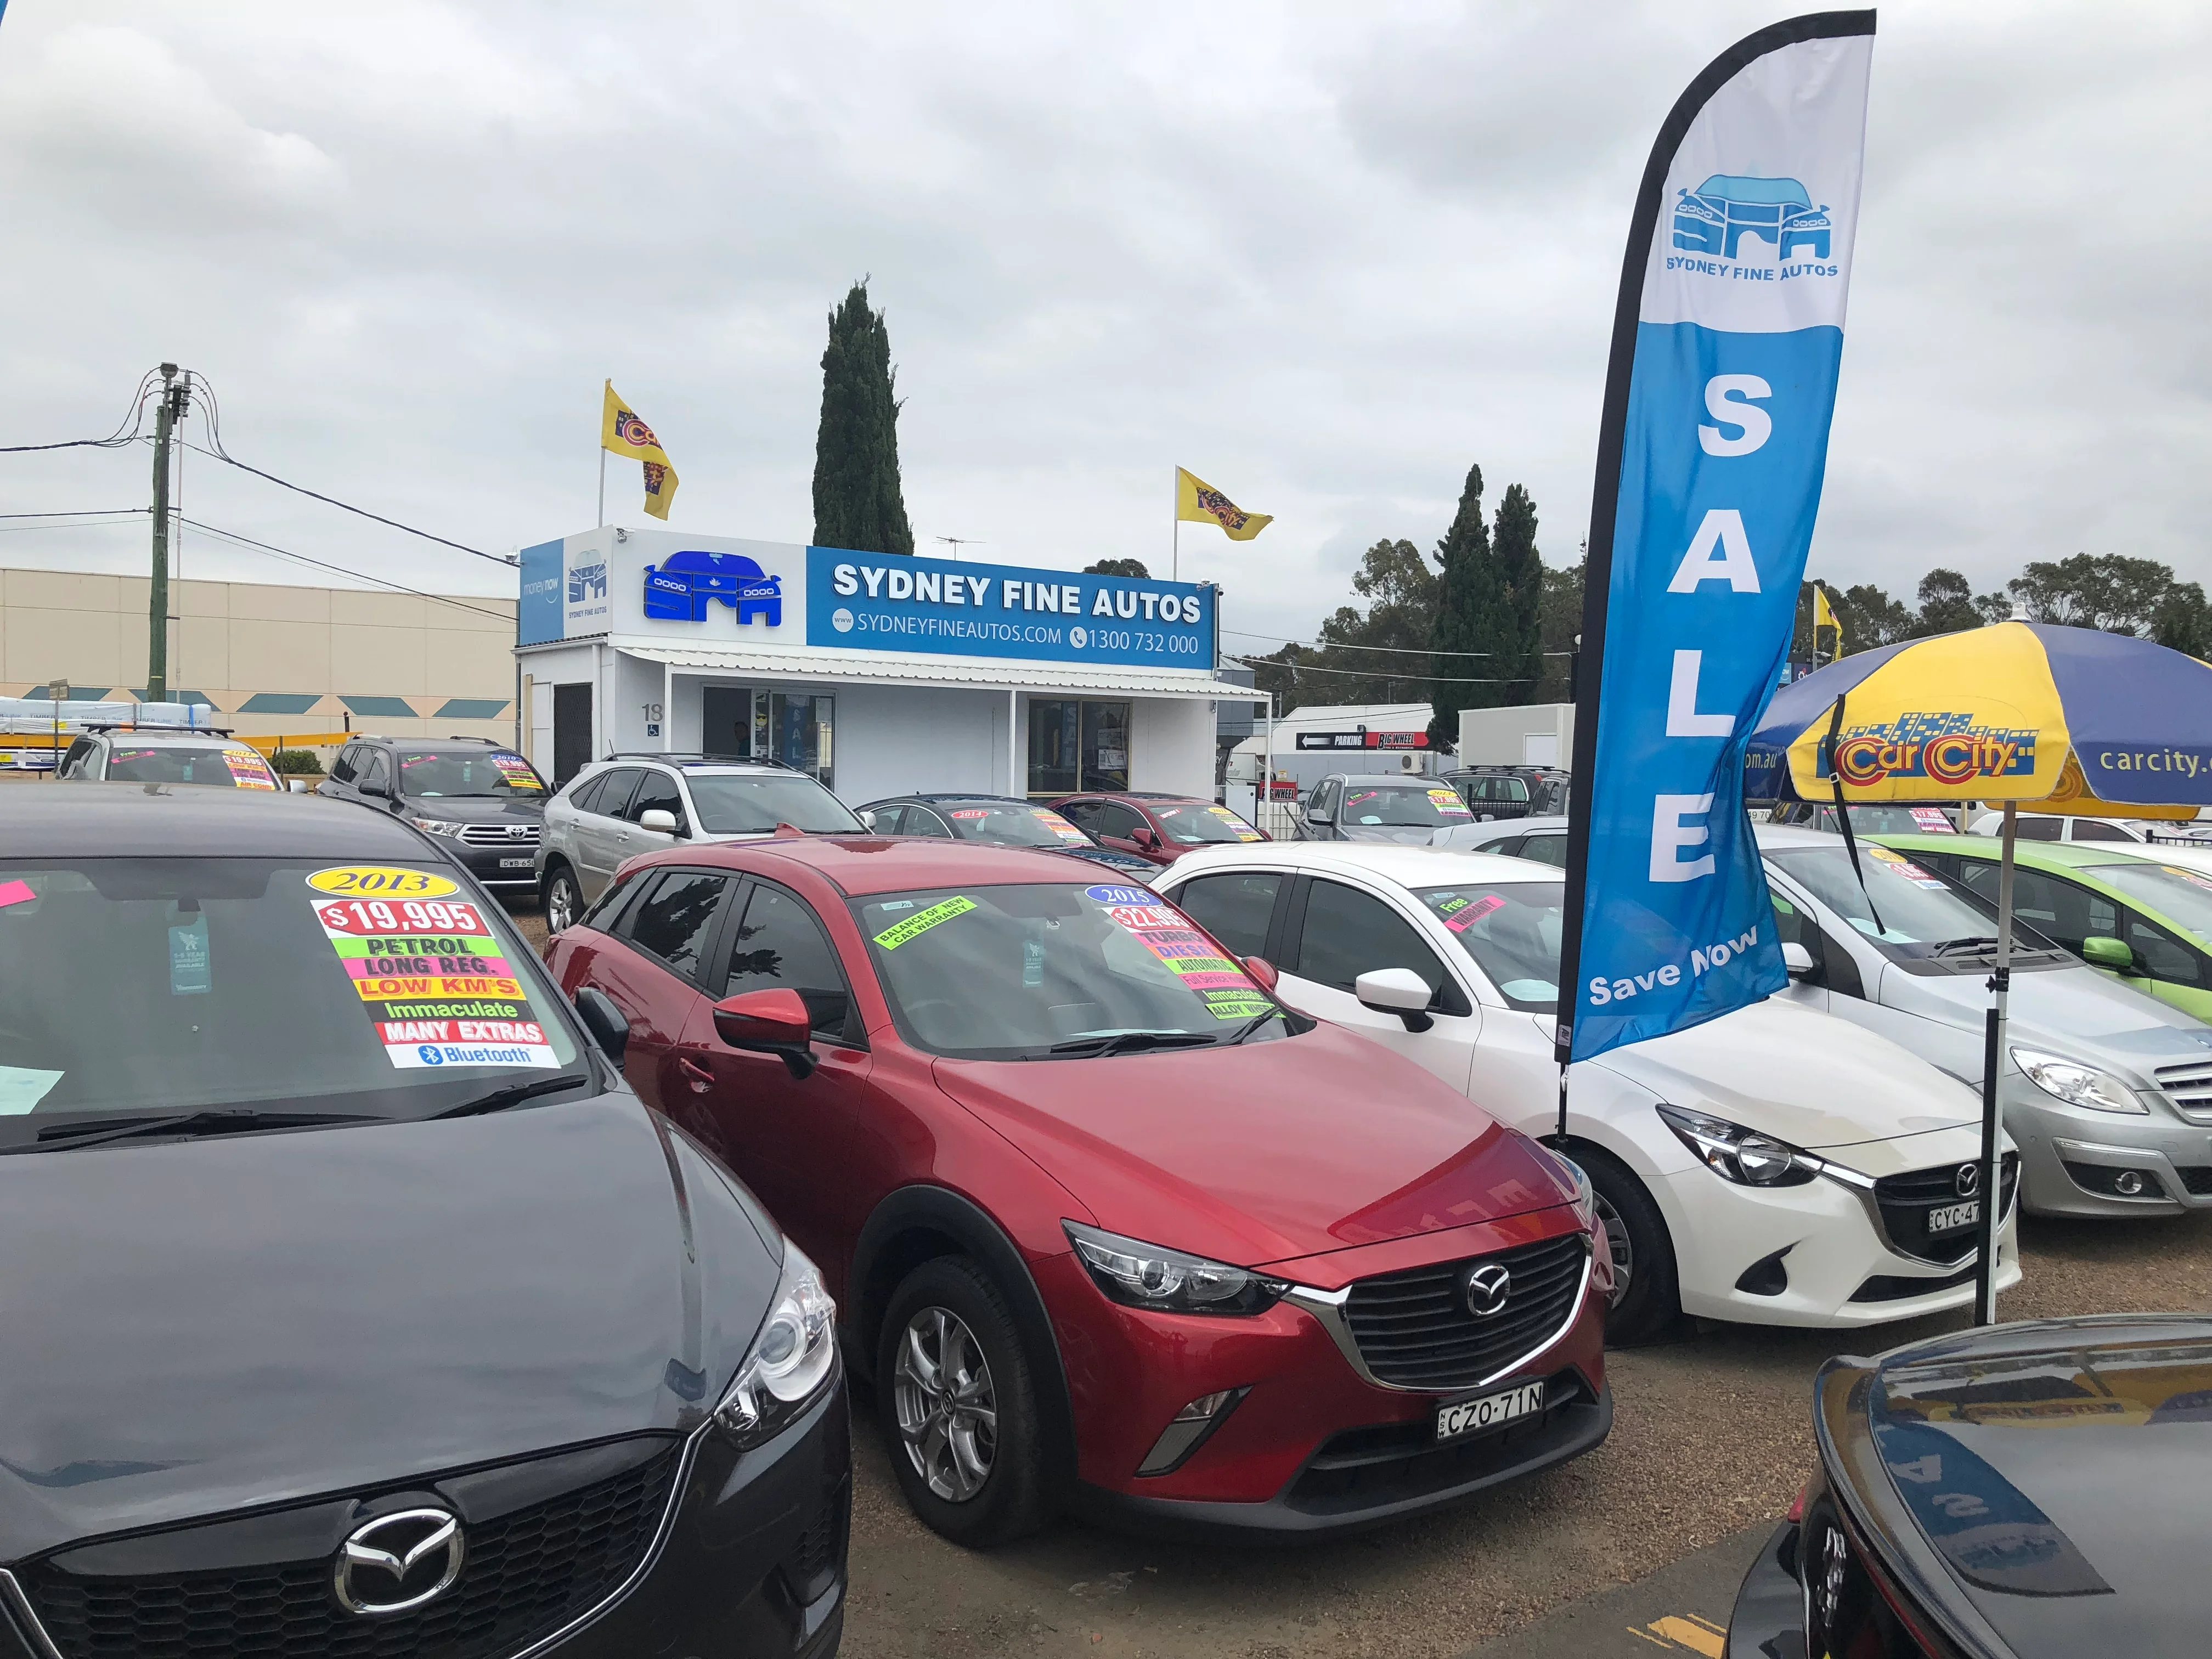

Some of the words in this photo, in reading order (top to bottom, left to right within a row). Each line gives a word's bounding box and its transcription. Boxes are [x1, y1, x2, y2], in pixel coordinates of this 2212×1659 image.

[1667, 256, 1729, 276] SYDNEY
[1733, 267, 1774, 281] FINE
[1780, 264, 1838, 281] AUTOS
[832, 563, 991, 606] SYDNEY
[1002, 579, 1081, 614] FINE
[1091, 589, 1200, 624] AUTOS
[568, 610, 584, 619] SYDNEY
[857, 613, 1061, 644] SYDNEYFINEAUTOS.COM
[1089, 629, 1130, 650] 1300
[1135, 633, 1164, 652] 732
[1169, 635, 1198, 654] 000
[1649, 374, 1773, 882] SALE
[642, 703, 663, 722] 18
[1334, 735, 1363, 746] PARKING
[1377, 733, 1392, 749] BIG
[1392, 733, 1415, 744] WHEEL
[1745, 752, 1778, 769] om.au
[1835, 736, 1920, 787] Car
[1922, 734, 2019, 786] City
[2100, 748, 2212, 778] carcity.
[1262, 787, 1274, 800] BG
[1274, 787, 1295, 800] WHEEL
[329, 872, 431, 891] 2013
[1101, 889, 1150, 902] 2015
[1439, 898, 1468, 912] Free
[1451, 899, 1497, 926] WARRANTY
[329, 901, 477, 931] $19,995
[879, 915, 927, 941] BALANCE
[926, 907, 939, 917] OF
[941, 898, 964, 910] NEW
[894, 929, 917, 943] CAR
[915, 904, 967, 930] WARRANTY
[1114, 907, 1190, 928] $22,995
[366, 938, 476, 956] PETROL
[1137, 932, 1203, 945] TURBO
[1155, 945, 1220, 958] DIESEL
[365, 957, 436, 976] LONG
[439, 957, 499, 975] REG.
[1177, 959, 1233, 972] AUTOMATIC
[1590, 964, 1681, 1006] Save
[1691, 924, 1758, 978] Now
[359, 979, 432, 996] LOW
[442, 979, 520, 996] KM'S
[1182, 975, 1200, 985] Full
[1201, 974, 1229, 984] Service
[1202, 989, 1264, 1001] Immaculate
[384, 1002, 518, 1018] Immaculate
[1212, 1004, 1245, 1015] ALLOY
[383, 1022, 449, 1041] MANY
[458, 1022, 544, 1042] EXTRAS
[445, 1047, 531, 1063] Bluetooth
